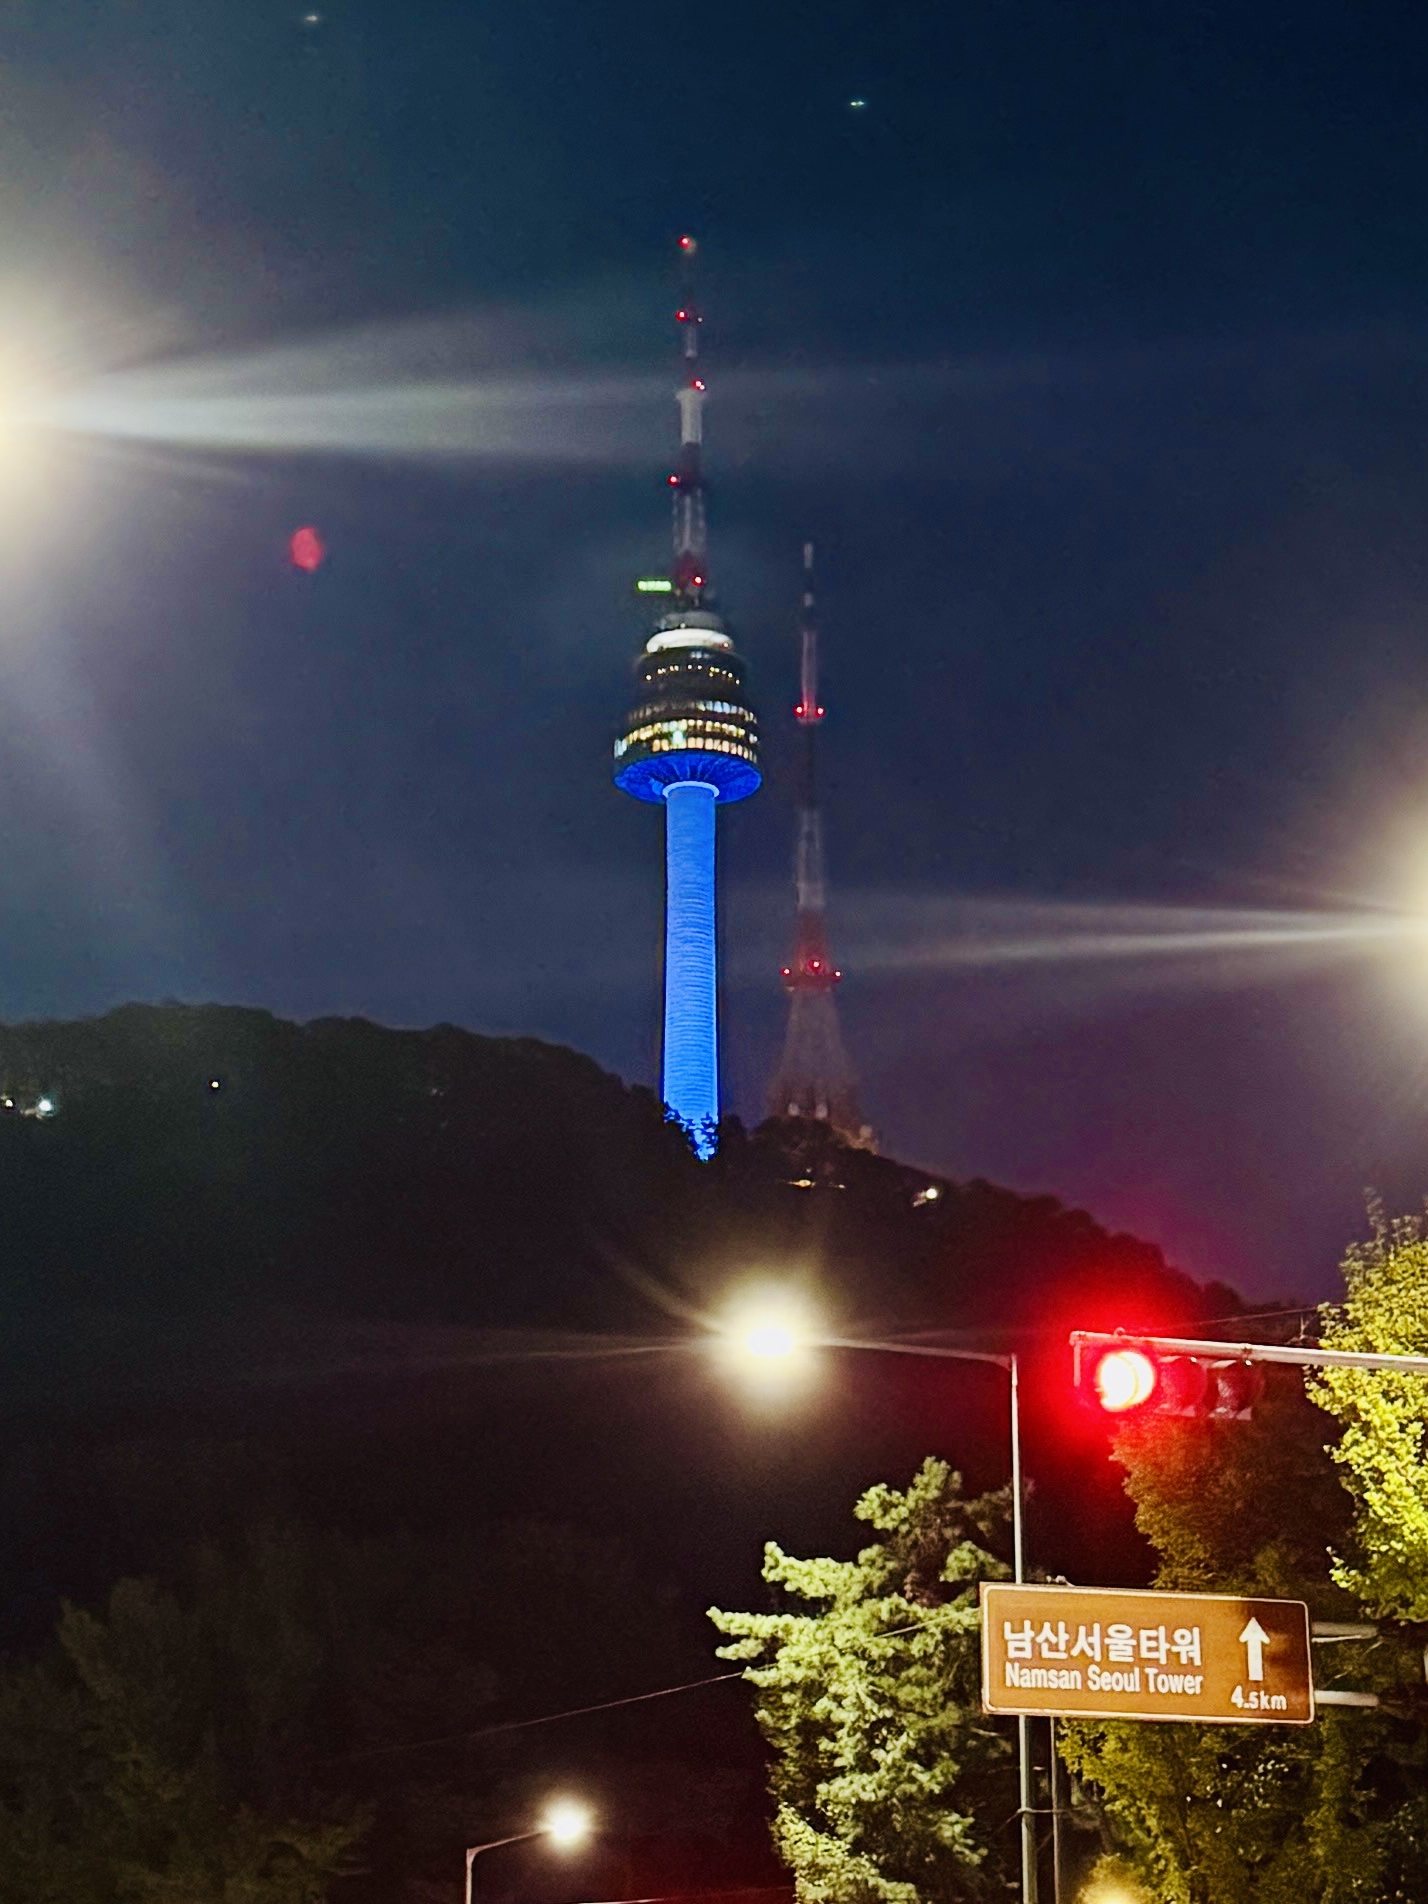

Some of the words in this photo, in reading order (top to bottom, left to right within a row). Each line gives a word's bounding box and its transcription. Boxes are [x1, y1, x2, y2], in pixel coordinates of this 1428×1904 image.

[1003, 1619, 1203, 1667] 남산서울타워
[1005, 1661, 1082, 1690] Namsan
[1086, 1665, 1141, 1693] Seoul
[1144, 1667, 1204, 1695] Tower
[1230, 1684, 1288, 1711] 4.5km
